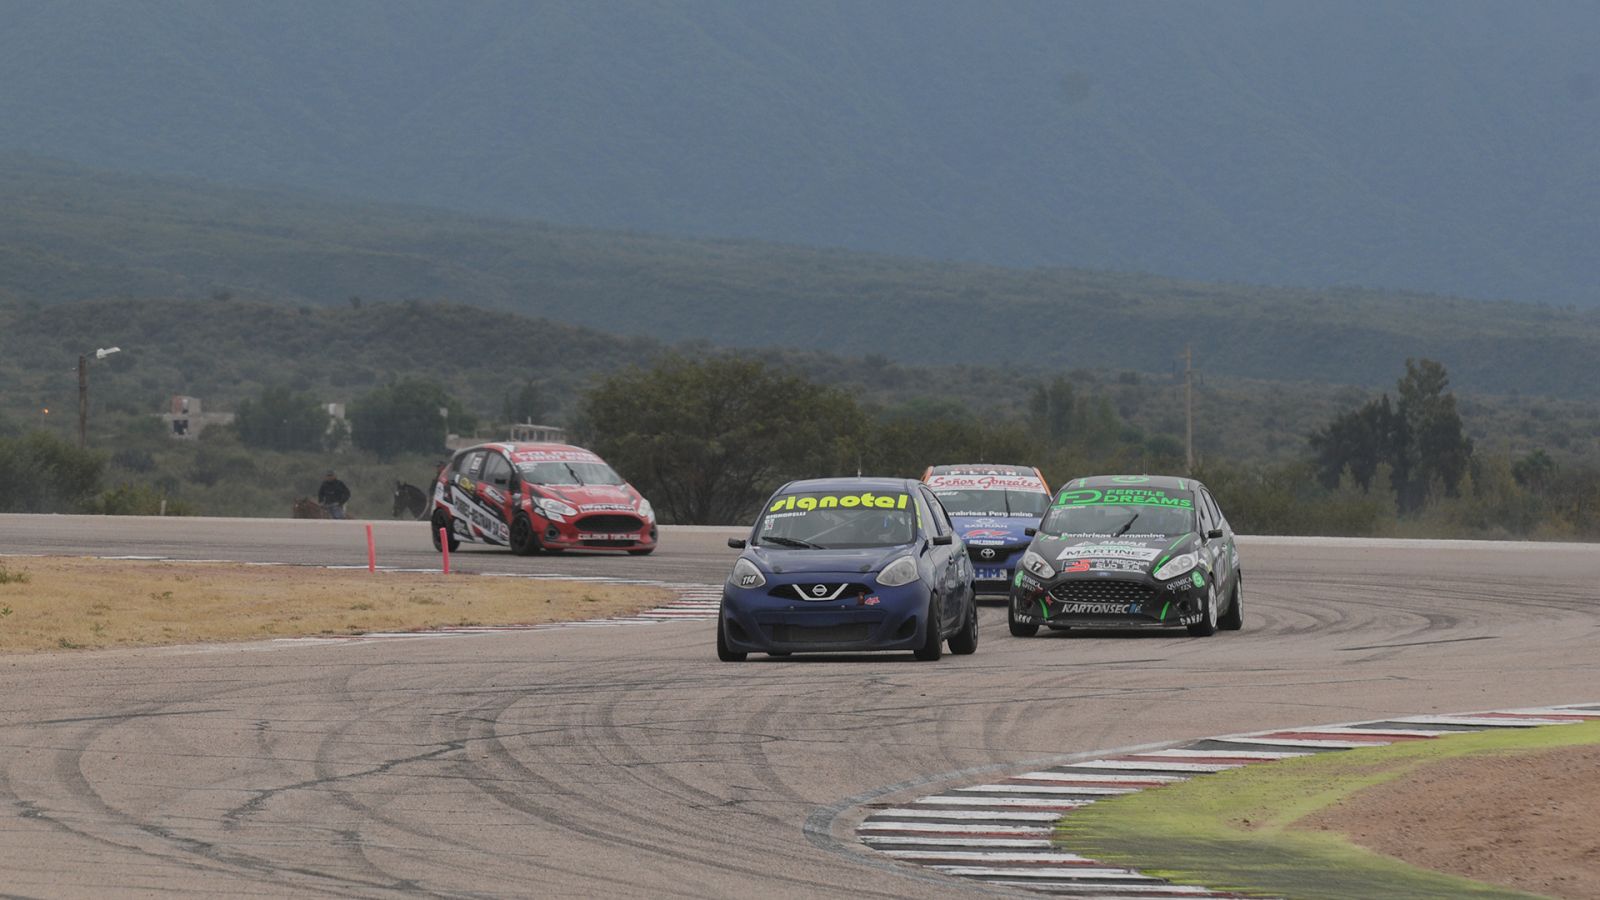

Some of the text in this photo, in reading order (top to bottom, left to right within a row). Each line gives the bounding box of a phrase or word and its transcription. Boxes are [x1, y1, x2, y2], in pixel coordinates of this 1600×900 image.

[928, 476, 1041, 489] Señor González
[1106, 489, 1166, 497] FERTILE
[1103, 495, 1192, 507] DREAMS
[947, 510, 987, 518] arabrisas
[1065, 548, 1152, 557] MARTINEZ
[1061, 603, 1131, 614] KARTONSEC
